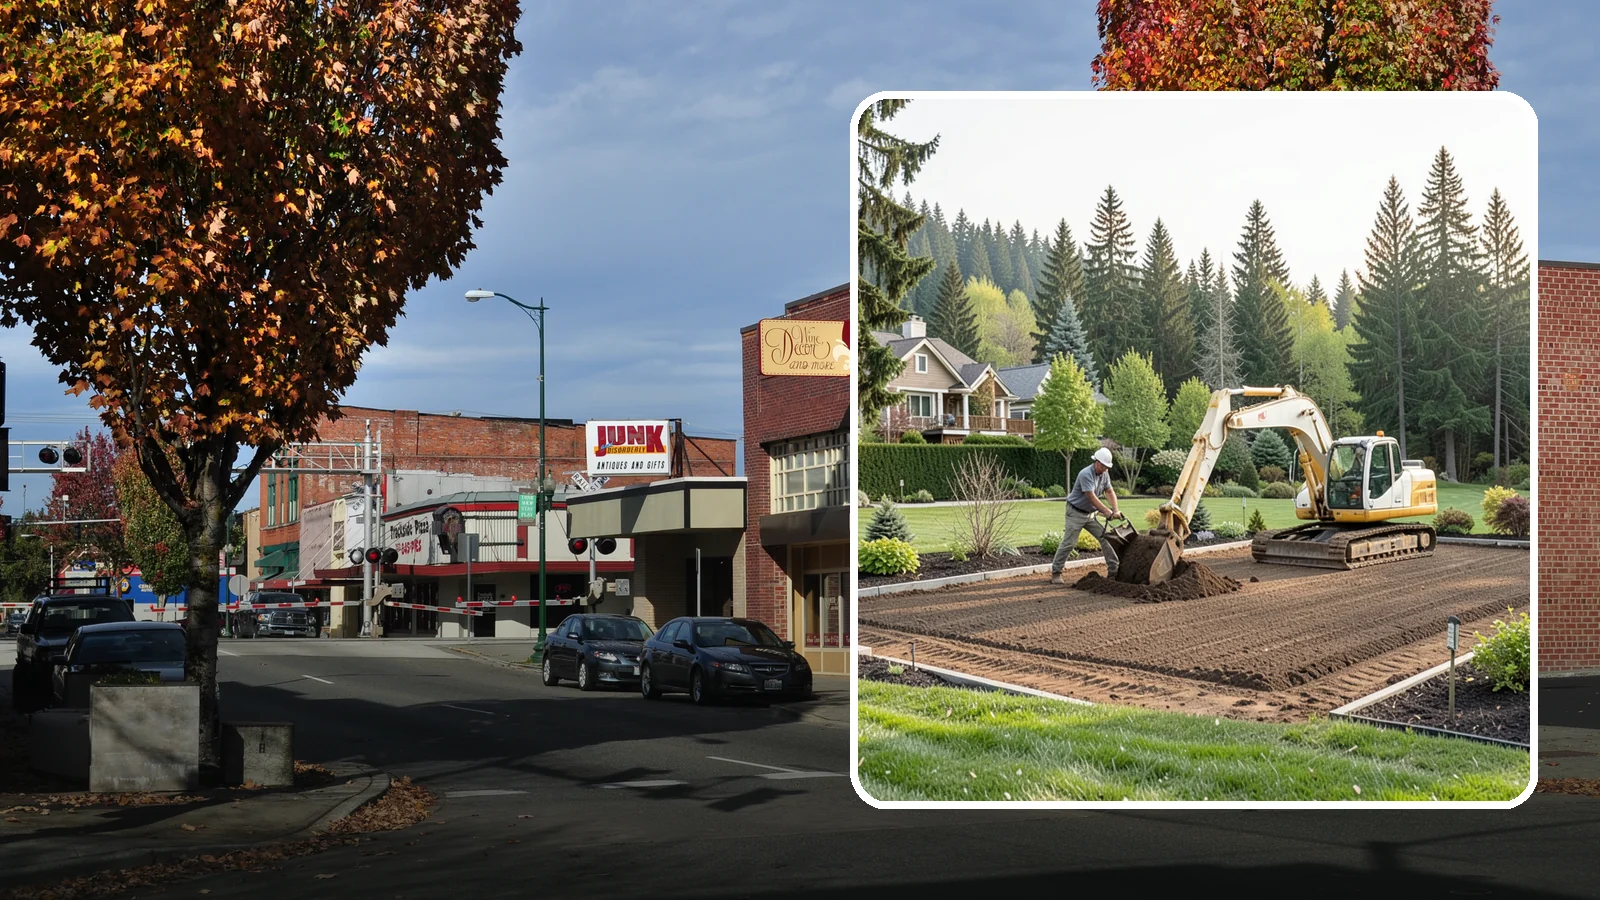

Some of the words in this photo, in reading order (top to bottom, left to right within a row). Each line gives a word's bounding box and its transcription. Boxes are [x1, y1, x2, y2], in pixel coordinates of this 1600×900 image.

[595, 425, 664, 457] JUNK
[607, 446, 646, 454] DISORDERLY
[597, 461, 628, 470] ANTIQUES
[631, 461, 644, 470] AND
[646, 460, 665, 470] GIFTS
[414, 519, 429, 535] Pizza
